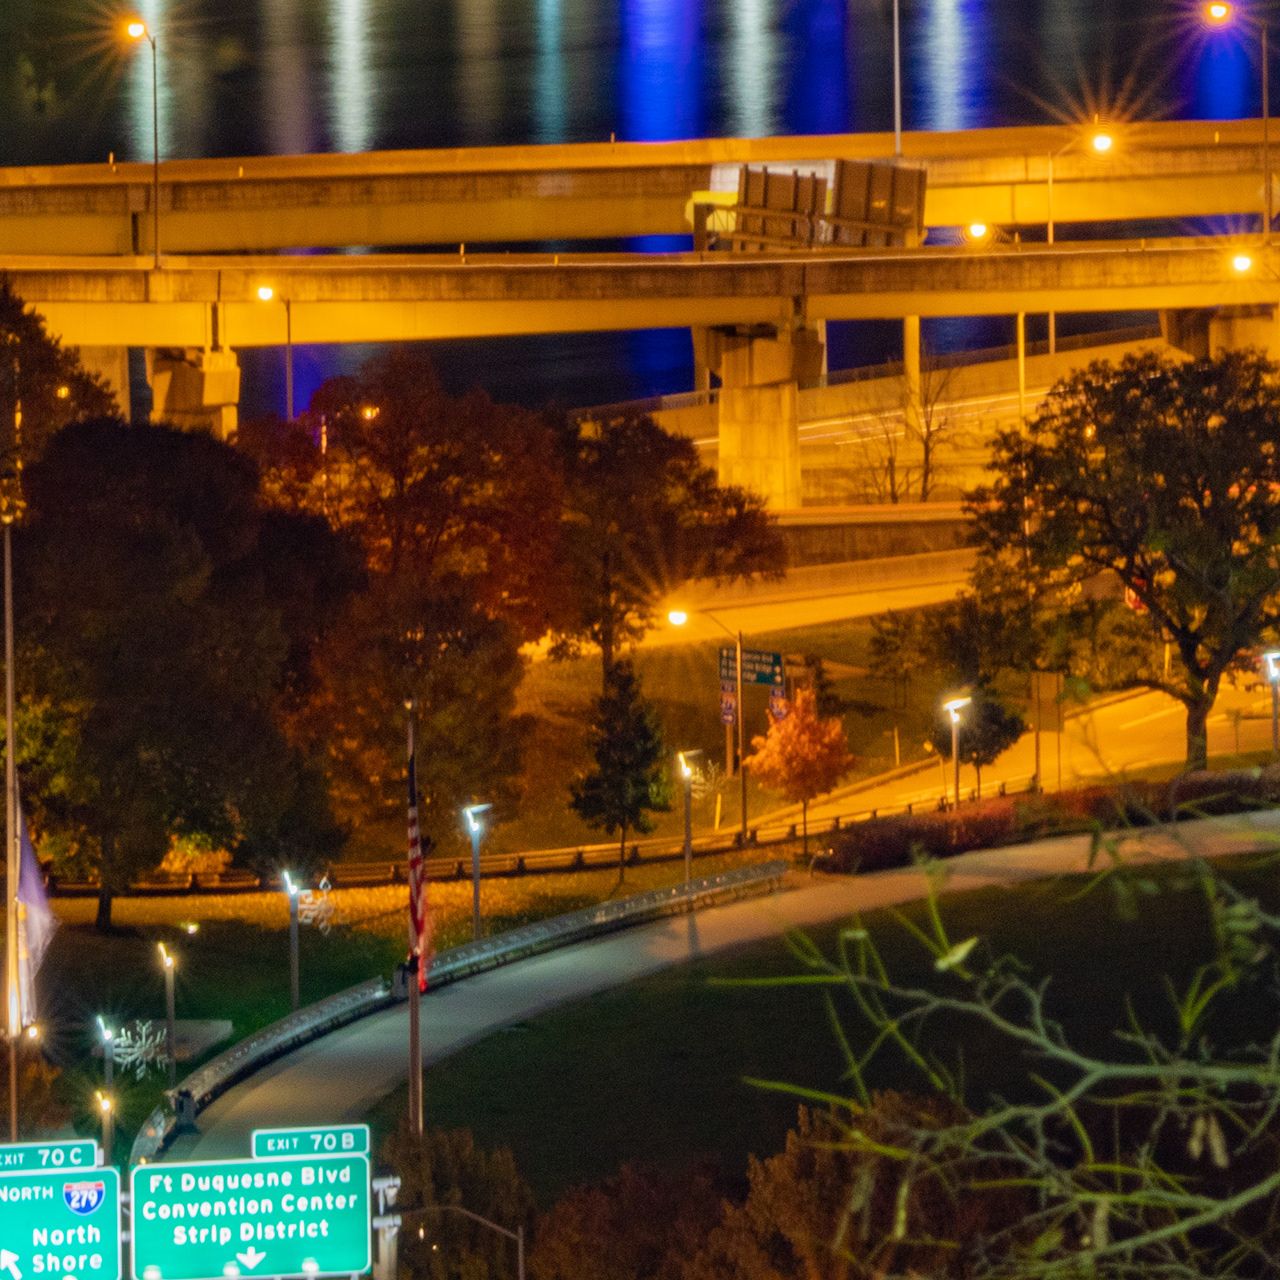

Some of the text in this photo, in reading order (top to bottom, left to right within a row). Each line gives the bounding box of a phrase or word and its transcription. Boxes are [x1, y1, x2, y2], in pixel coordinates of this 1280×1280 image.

[268, 1138, 297, 1150] EXIT
[150, 1166, 350, 1196] Ft Duquesne Blvd
[70, 1189, 99, 1209] 279
[143, 1193, 357, 1220] Convention Center
[33, 1225, 100, 1246] North
[174, 1220, 328, 1245] Strip District
[33, 1253, 102, 1272] Shore
